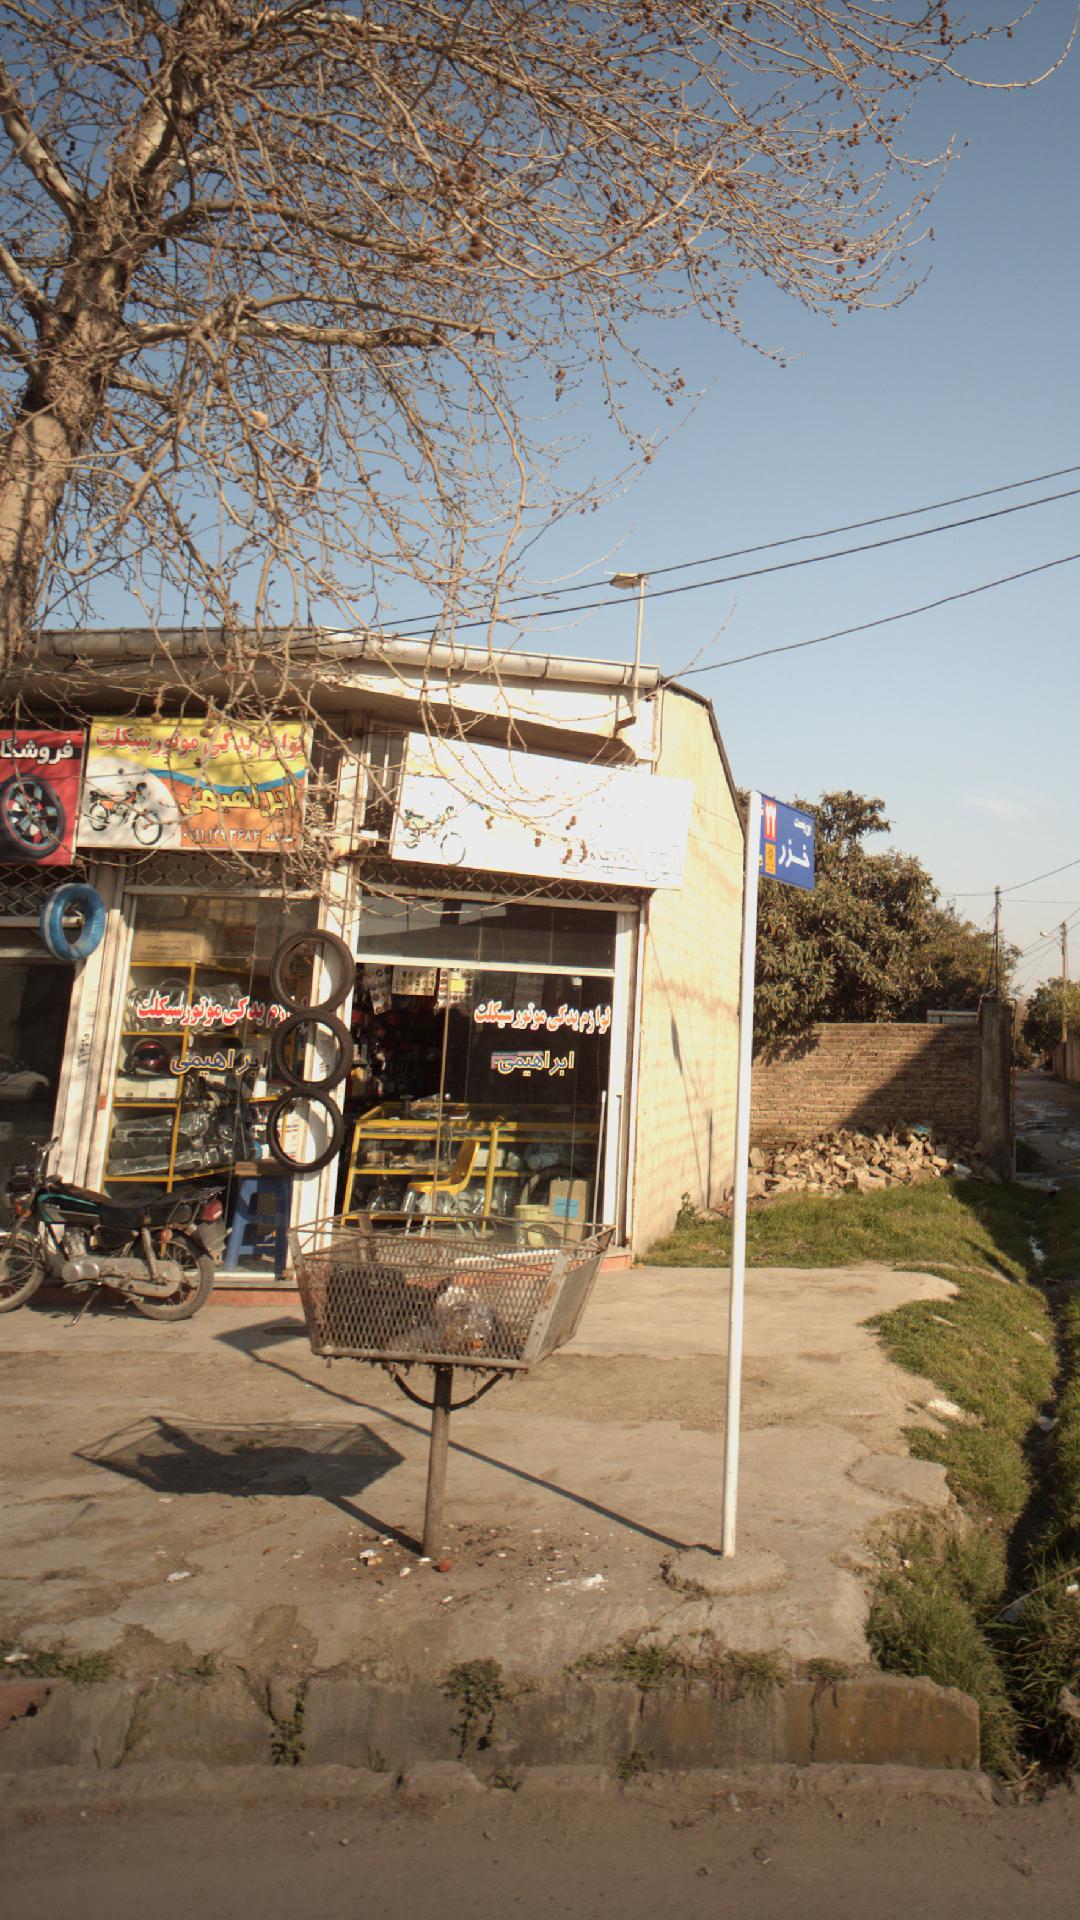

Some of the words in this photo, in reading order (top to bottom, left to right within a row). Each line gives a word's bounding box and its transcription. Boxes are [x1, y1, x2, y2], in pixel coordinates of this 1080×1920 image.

[0, 736, 74, 765] فروشگا
[179, 783, 294, 816] ابراهیمی
[579, 1005, 611, 1034] لوازم
[497, 1050, 575, 1076] ابراهیمی
